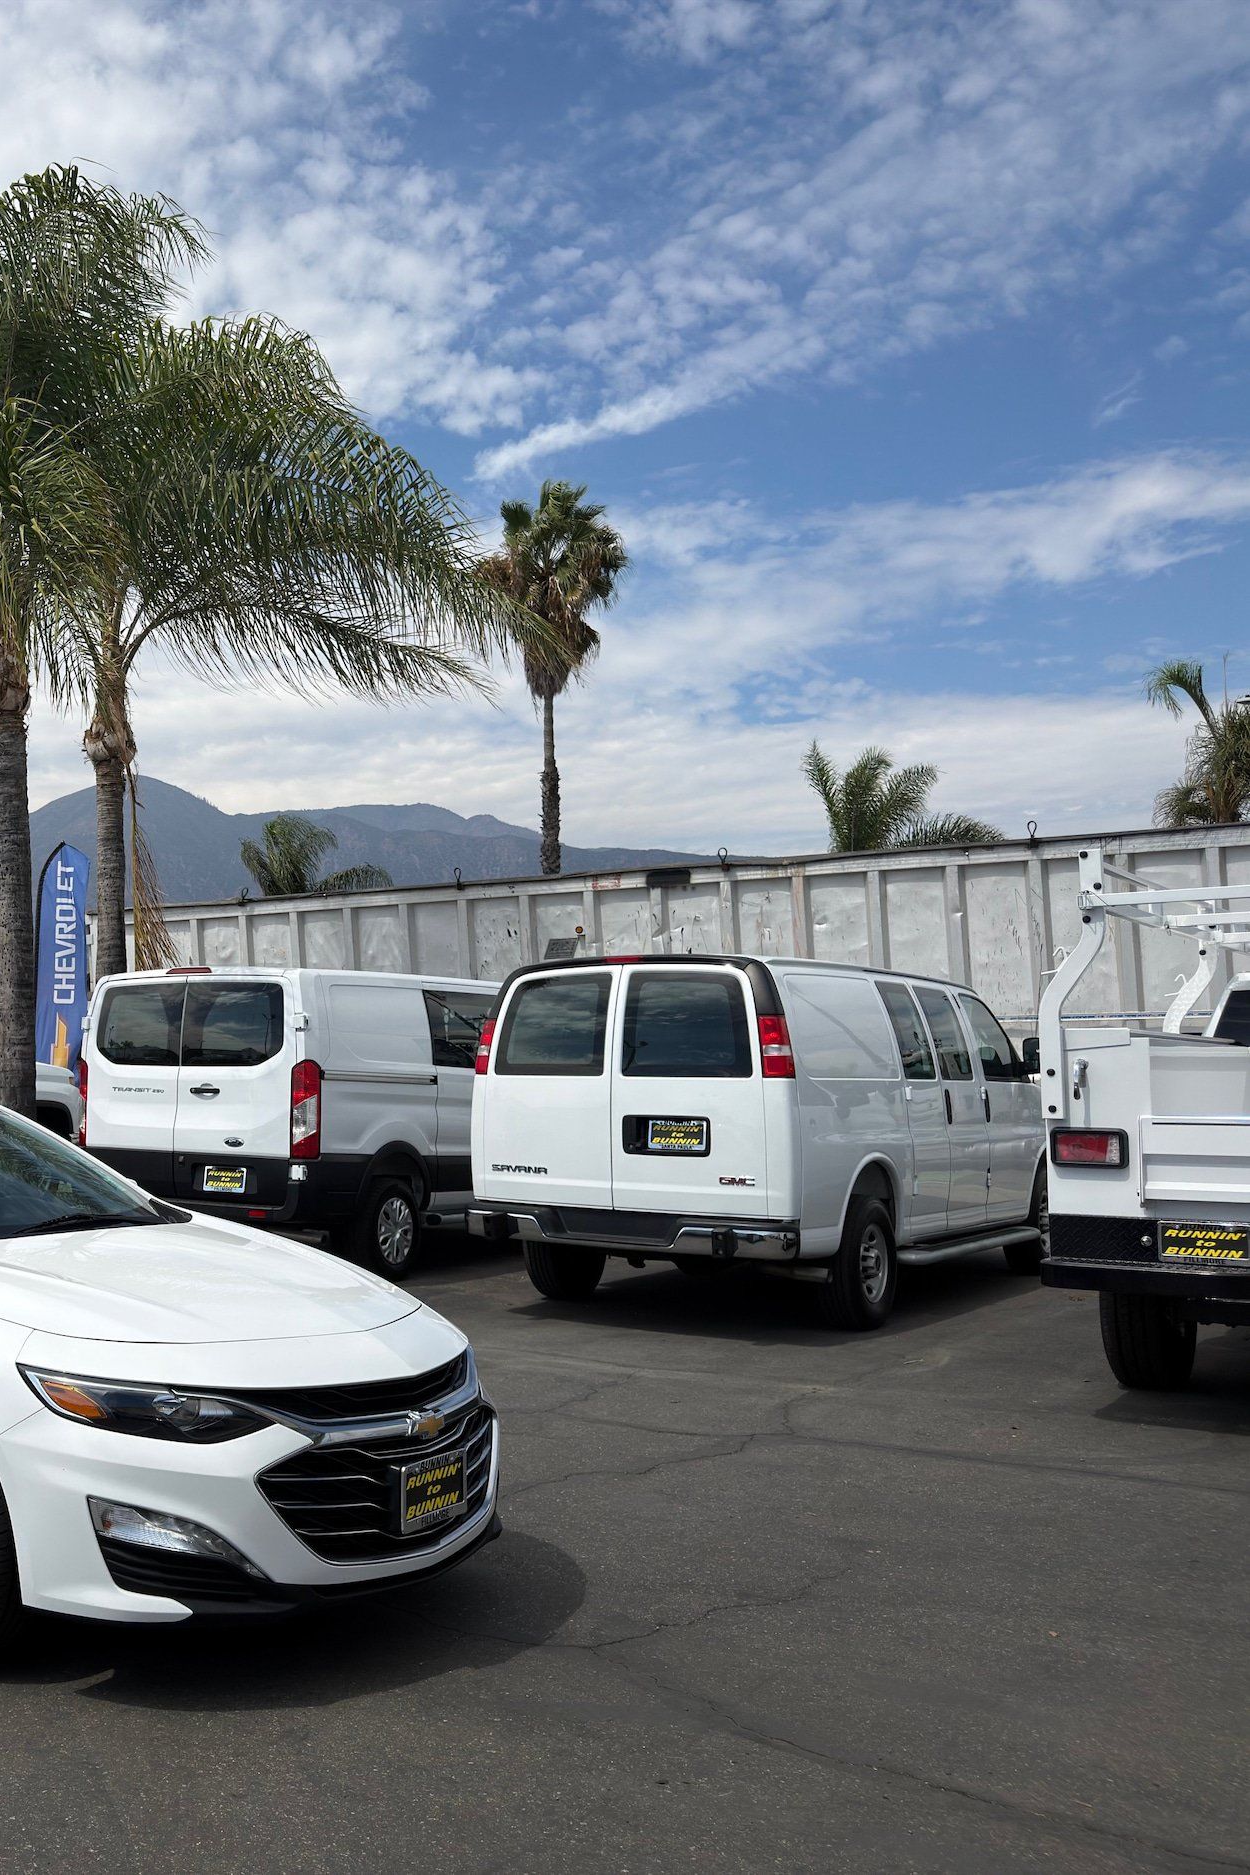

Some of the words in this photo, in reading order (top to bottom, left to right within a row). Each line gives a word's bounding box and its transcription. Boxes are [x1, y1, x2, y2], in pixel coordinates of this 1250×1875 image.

[53, 860, 77, 1005] CHEVROLET
[651, 1137, 701, 1145] BUNNIN
[492, 1164, 548, 1175] SAVANA
[719, 1176, 756, 1187] GMC
[1164, 1228, 1247, 1241] RUNNIN'
[1164, 1246, 1244, 1259] BUNNIN
[406, 1462, 462, 1490] RUNNIN'
[426, 1484, 442, 1496] to
[406, 1490, 460, 1520] BUNNIN
